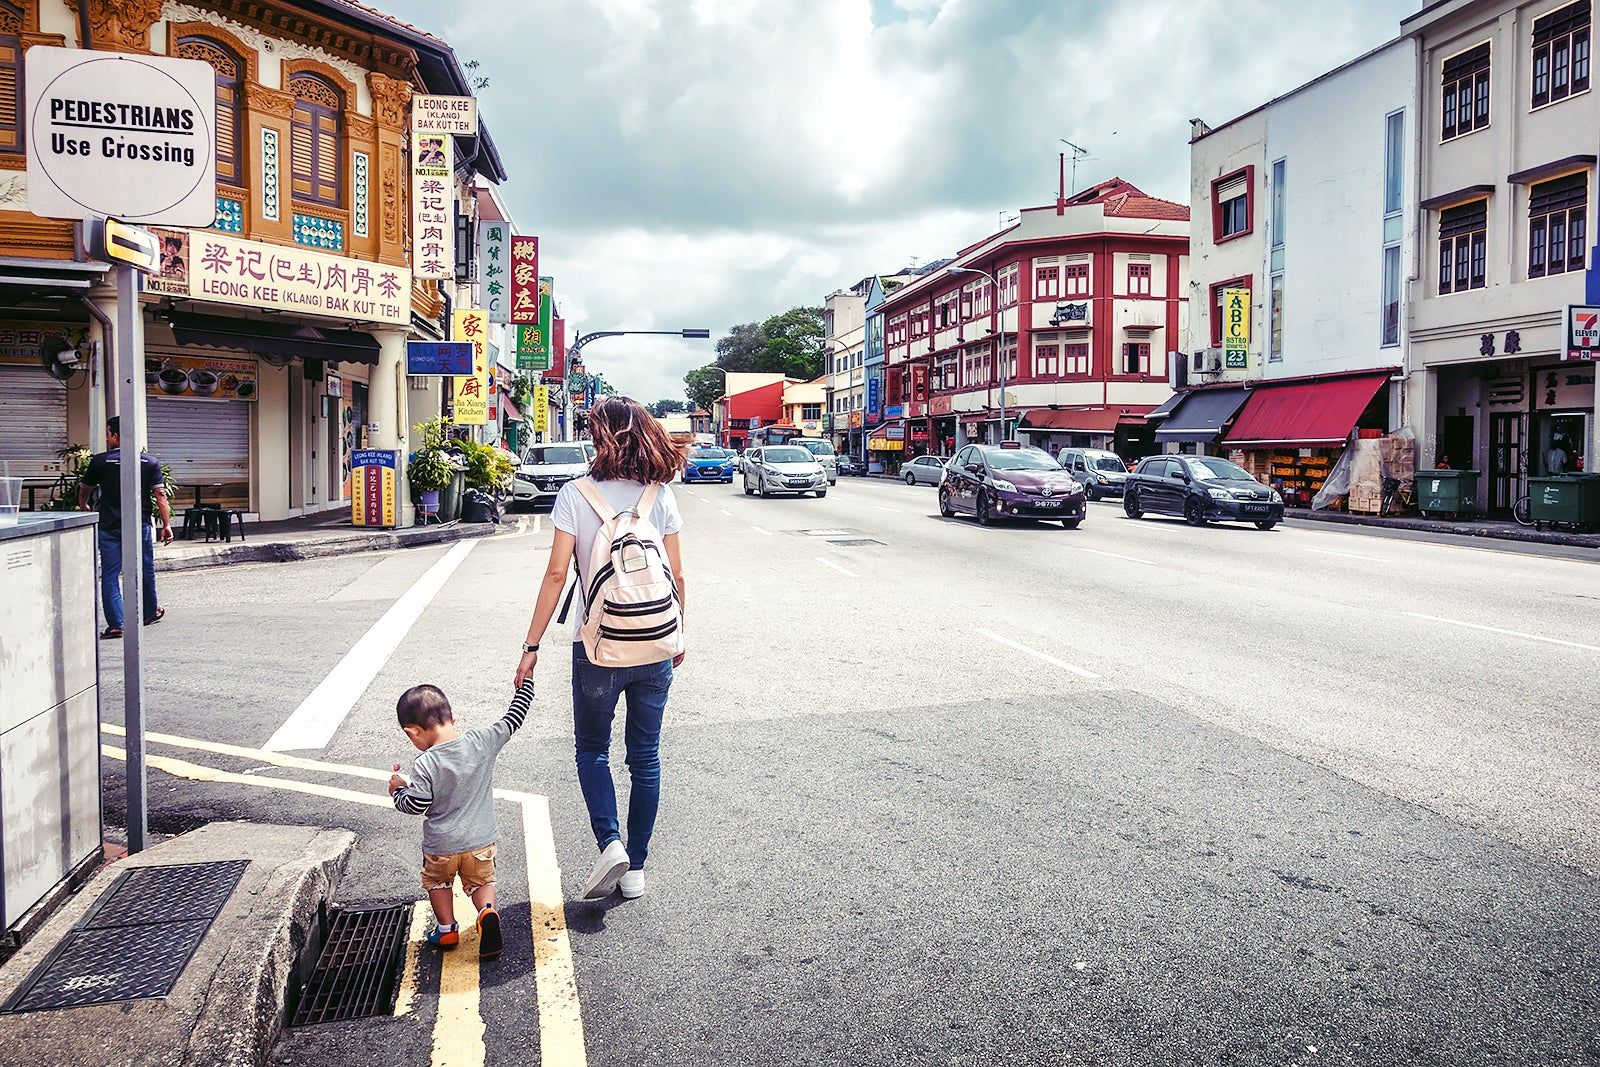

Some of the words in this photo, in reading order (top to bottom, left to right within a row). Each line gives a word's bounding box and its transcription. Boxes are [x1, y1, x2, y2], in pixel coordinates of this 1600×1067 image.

[418, 99, 448, 110] LEONG
[451, 101, 469, 111] KEE
[50, 98, 194, 130] PEDESTRIANS
[427, 111, 460, 120] (KLANG)
[417, 119, 434, 129] BAK
[436, 120, 452, 130] KUT
[454, 121, 470, 131] TEH
[51, 132, 91, 157] Use
[102, 136, 195, 167] Crossing
[415, 168, 431, 176] NO.1
[486, 226, 504, 296] 國貨批發
[147, 279, 166, 292] NO.1
[202, 278, 249, 299] LEONG
[252, 285, 279, 303] KEE
[282, 292, 322, 308] (KLANG)
[326, 297, 350, 312] BAK
[353, 300, 376, 315] KUT
[379, 303, 400, 319] TEH
[513, 311, 535, 321] 257
[1229, 350, 1244, 362] 23
[1582, 351, 1590, 359] 24
[454, 399, 465, 407] Jia
[466, 399, 487, 409] Xiang
[458, 407, 484, 416] Kitchen
